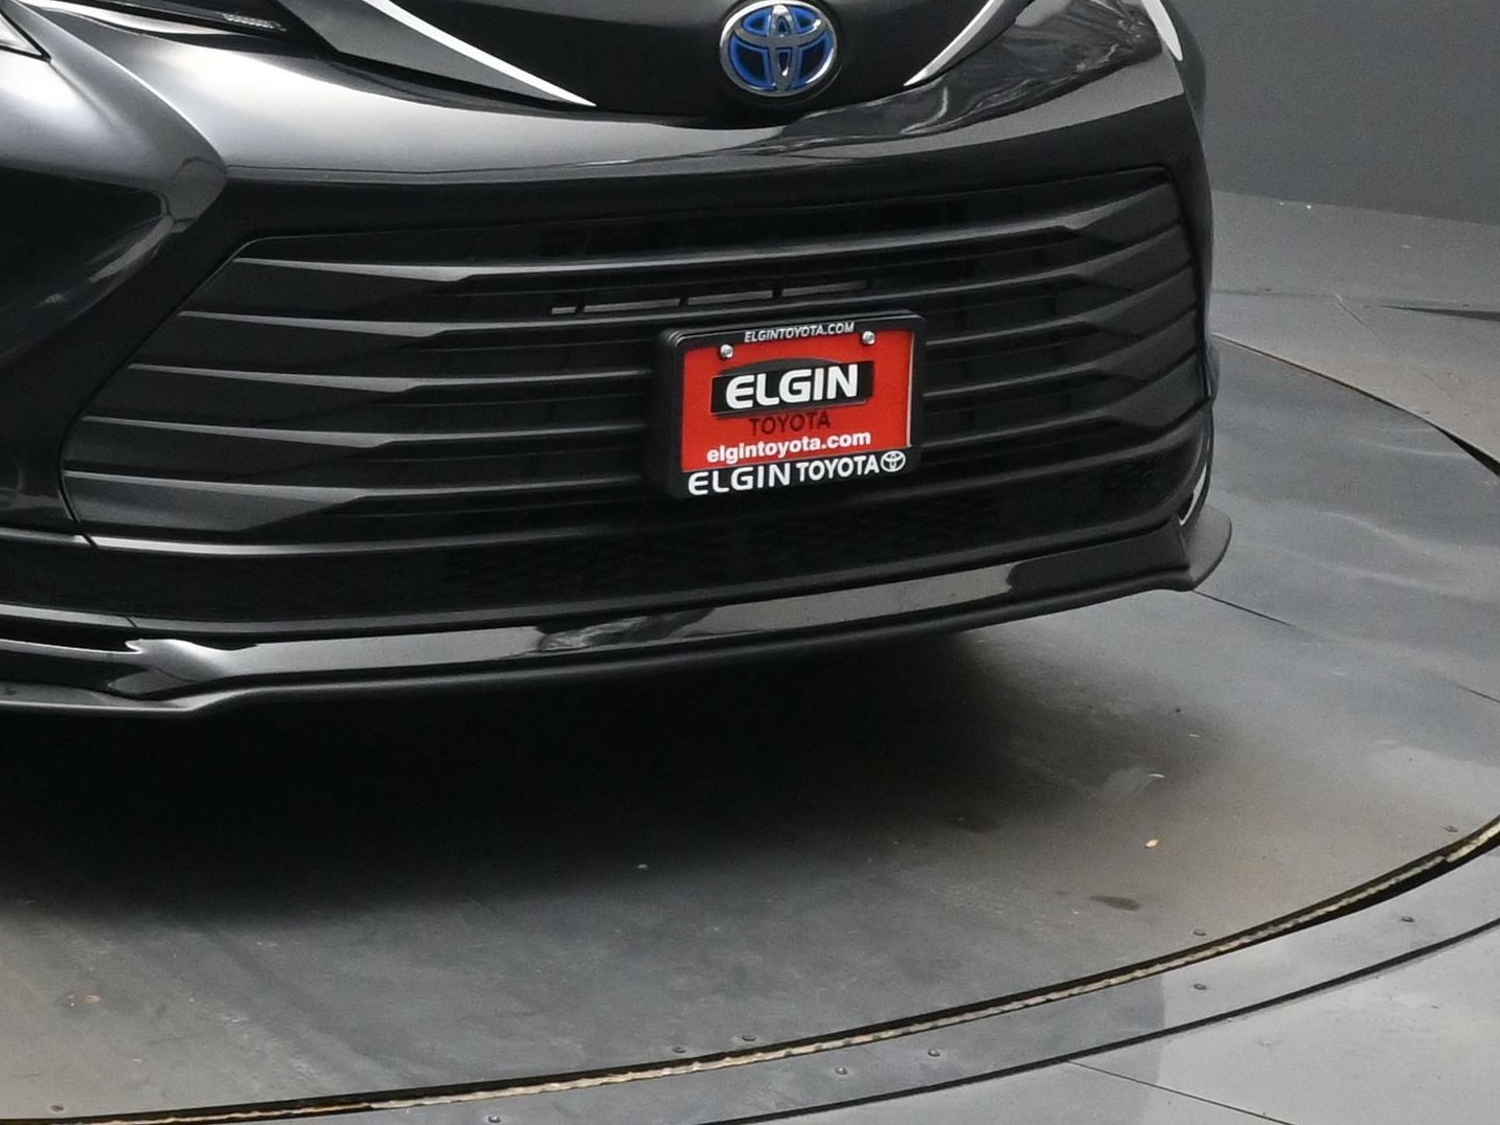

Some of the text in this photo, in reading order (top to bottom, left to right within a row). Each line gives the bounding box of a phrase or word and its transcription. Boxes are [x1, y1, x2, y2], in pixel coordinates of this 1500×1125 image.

[744, 322, 855, 343] ELGINTOYOTA.COM
[725, 364, 859, 409] ELGIN
[749, 411, 831, 436] TOYOTA
[706, 431, 871, 465] elgintoyota.com
[687, 455, 880, 496] ELGIN TOYOTA
